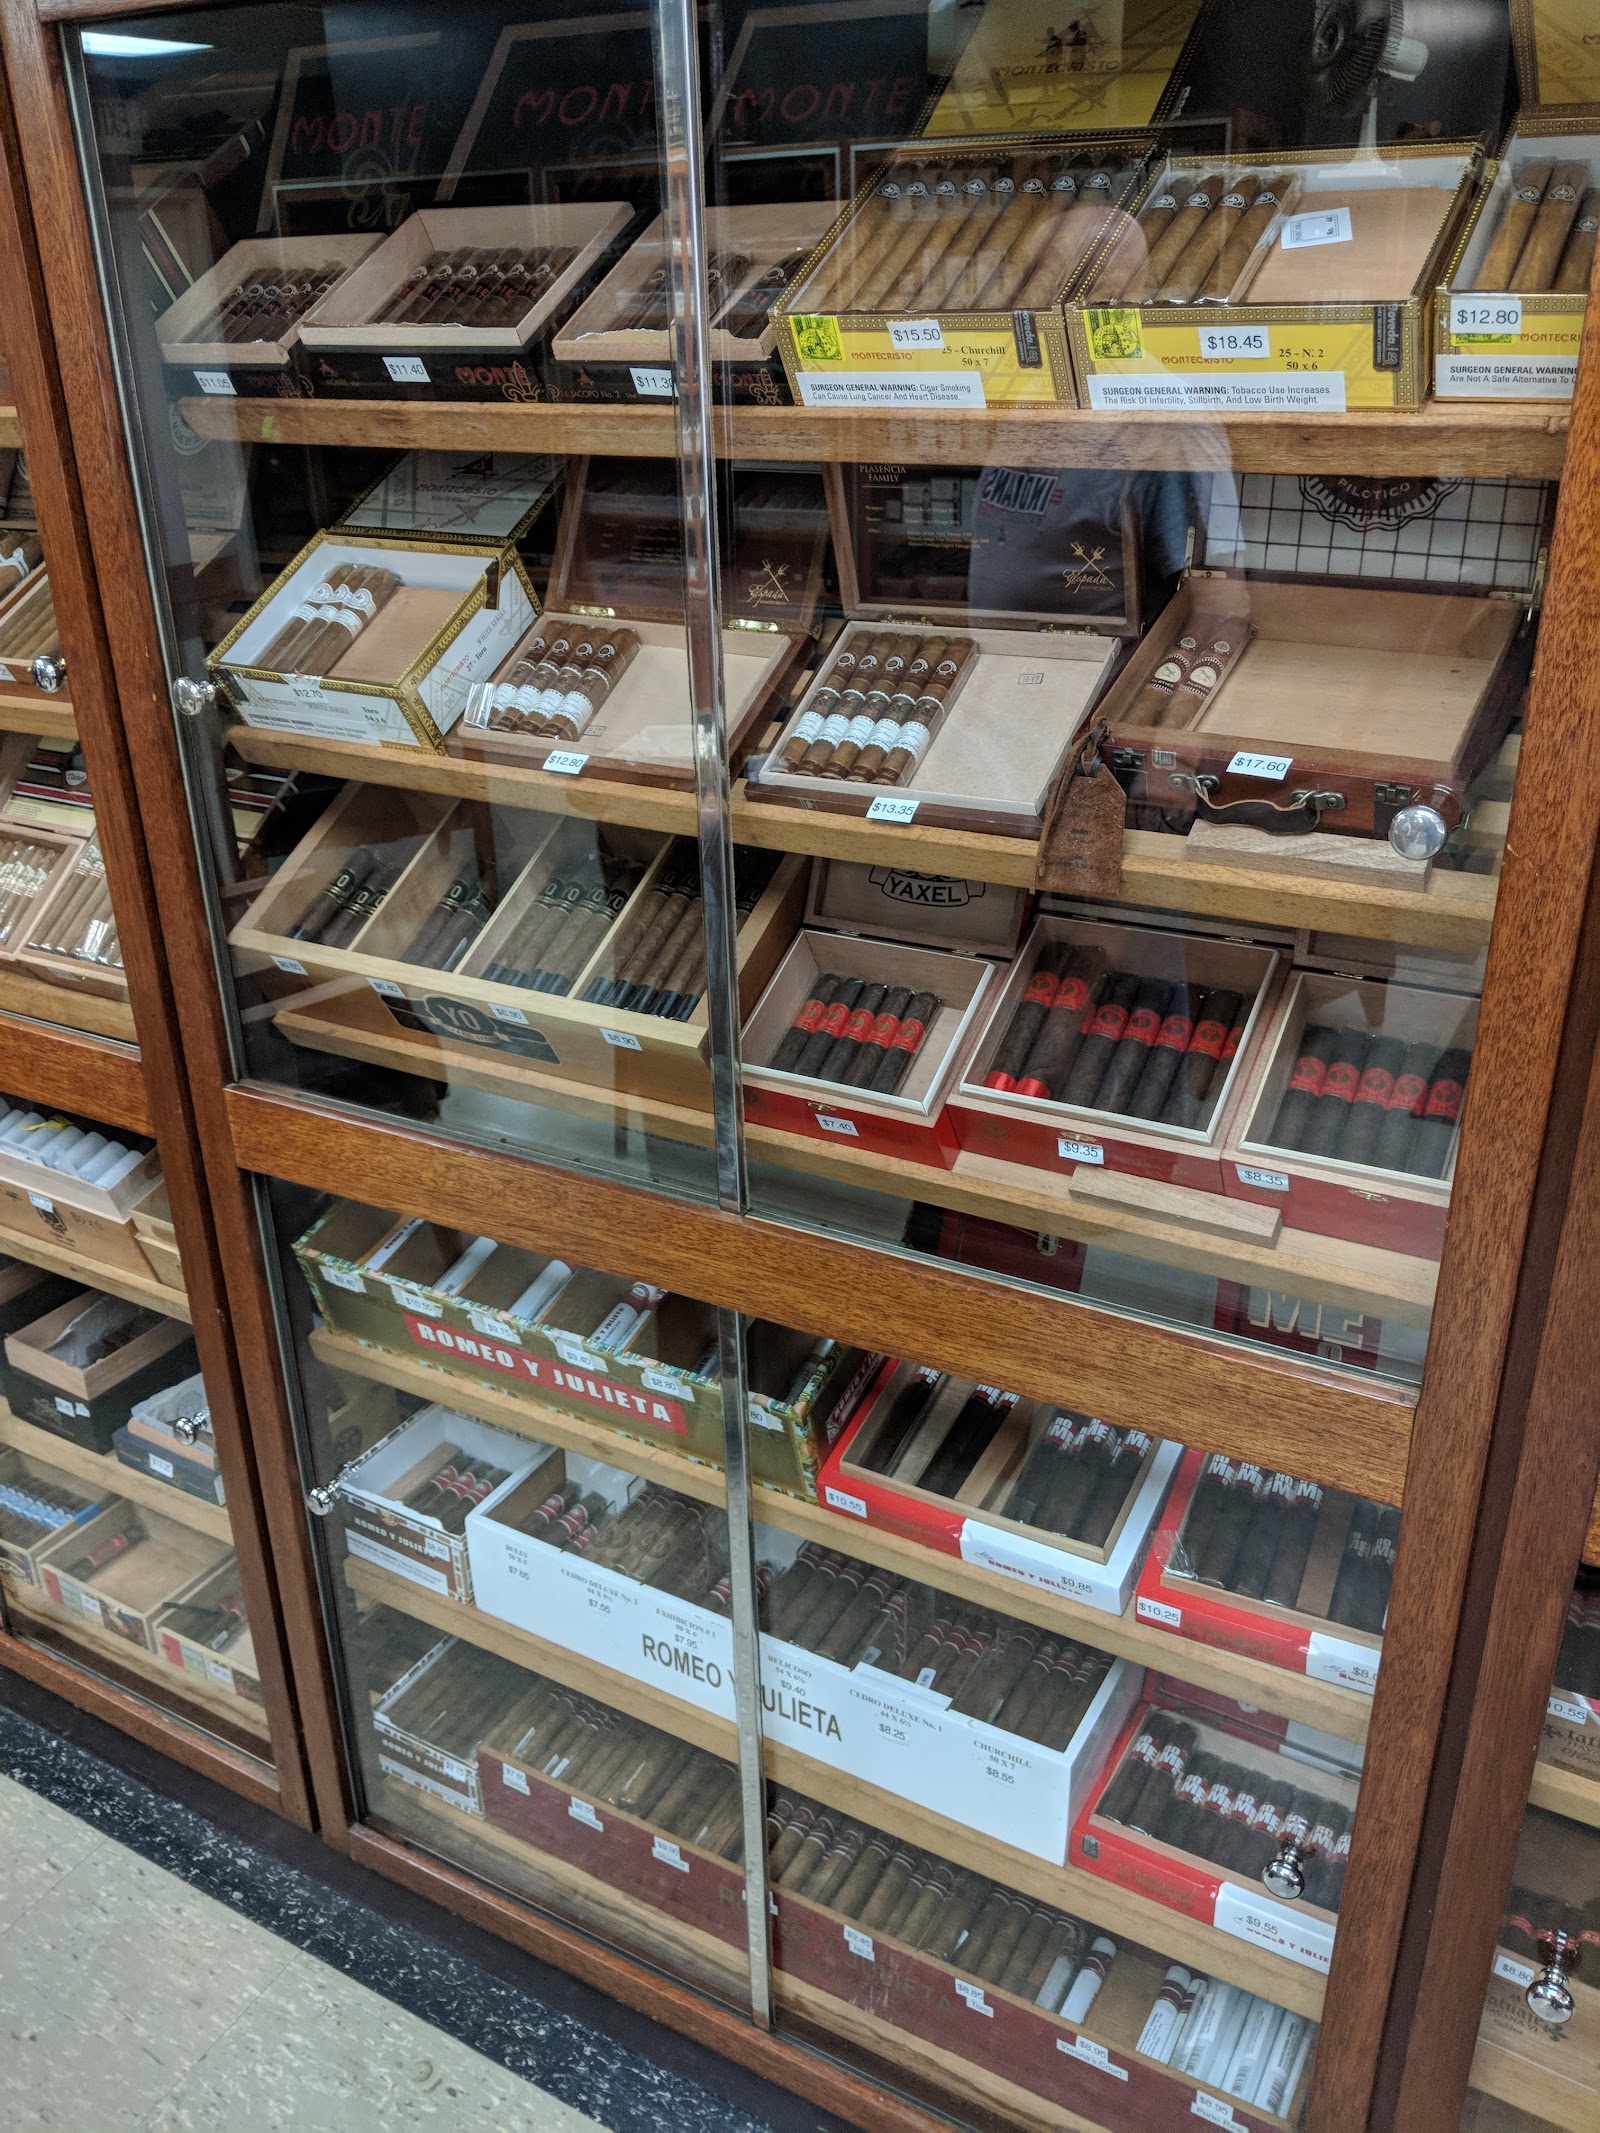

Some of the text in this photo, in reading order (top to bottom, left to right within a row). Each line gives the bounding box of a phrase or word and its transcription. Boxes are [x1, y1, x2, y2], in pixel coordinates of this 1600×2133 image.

[995, 58, 1122, 77] MONTECRISTO
[514, 80, 655, 128] MONT
[732, 77, 914, 124] MONTE
[291, 104, 427, 153] MONTE
[1457, 309, 1519, 324] $12.80
[893, 328, 941, 342] $15.50
[1207, 335, 1263, 350] $18.45
[1520, 333, 1581, 342] MONTECRI
[851, 352, 914, 361] MONTECRISTO
[961, 346, 1006, 355] Churchill
[1279, 349, 1324, 358] 25 2
[388, 363, 425, 376] $11.40
[962, 357, 989, 366] 50 7
[1286, 361, 1299, 370] 50
[1311, 361, 1318, 370] 6
[454, 366, 530, 386] MONTE
[1450, 366, 1491, 374] SURGEON
[1493, 366, 1533, 374] GENERAL
[199, 377, 231, 389] $11.05
[1450, 375, 1569, 384] Are Not A Safe Alternative To
[879, 384, 919, 392] WARNING:
[920, 384, 937, 393] Cigar
[939, 384, 971, 393] Smoking
[1102, 386, 1330, 395] SURGEON GENERAL WARNING: Tobacco Use Increases
[850, 393, 866, 402] Lung
[909, 393, 929, 401] Heart
[930, 393, 960, 401] Disease.
[1104, 395, 1319, 405] The Risk Of Infertility, Stillbirth, And Low Birth Weight.
[859, 464, 907, 475] PLASENCIA
[868, 473, 901, 482] FAMILY
[419, 483, 498, 496] MONTECRISTO
[1337, 478, 1411, 500] PILOTICO
[475, 646, 488, 661] Toro
[293, 688, 324, 698] $12.70
[361, 706, 379, 715] Toro
[548, 755, 584, 768] $12.80
[1234, 756, 1287, 772] $17.60
[872, 802, 916, 816] $13.35
[890, 876, 962, 903] YAXEL
[438, 1003, 480, 1031] YO
[822, 1119, 852, 1132] $7.40
[1063, 1141, 1099, 1157] $9.35
[1244, 1170, 1283, 1186] $8.35
[566, 1350, 592, 1366] $9.40
[416, 1321, 673, 1423] ROMEO Y JULIETA
[650, 1376, 677, 1392] $8.80
[828, 1492, 863, 1512] $10.55
[988, 1559, 1025, 1576] ROMEO
[1060, 1576, 1093, 1594] $9.85
[1138, 1602, 1179, 1622] $10.25
[674, 1633, 698, 1649] $7.95
[768, 1654, 812, 1678] BELICOSO
[641, 1633, 843, 1742] ROMEO ULIETA
[780, 1679, 806, 1697] $9.40
[849, 1689, 936, 1731] CEDRO DELUXE No.
[1548, 1701, 1586, 1720] 10.55
[879, 1723, 906, 1741] $8.25
[973, 1740, 1033, 1769] CHURCHILL
[989, 1754, 999, 1764] 50
[986, 1766, 1015, 1785] $8.55
[1246, 1915, 1279, 1935] $9.55
[1301, 1947, 1330, 1963] JULIE
[1502, 1963, 1533, 1983] $8.80
[957, 1983, 984, 2001] $8.85
[971, 2000, 990, 2015] Toro
[1079, 2039, 1107, 2059] $8.95
[1061, 2043, 1125, 2077] Verona's Court
[1199, 2096, 1229, 2116] $8.95
[1196, 2107, 1221, 2124] Porto
